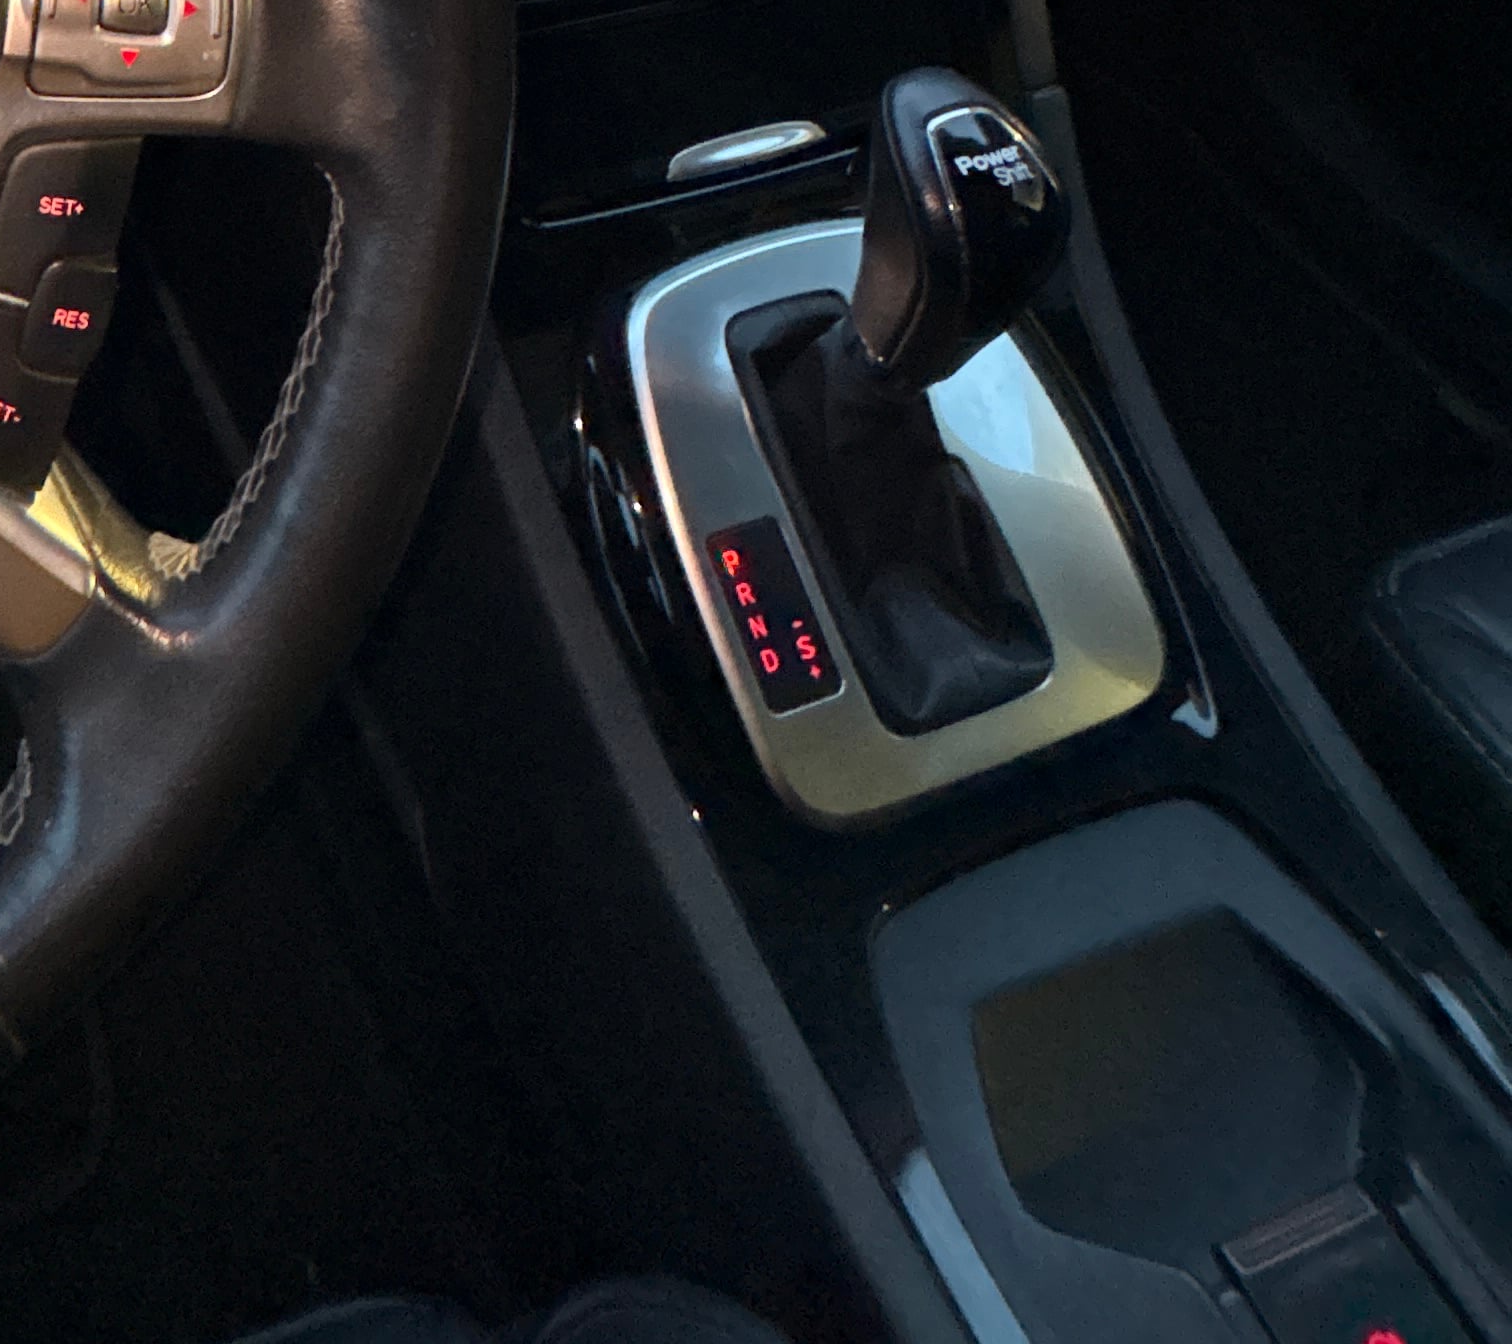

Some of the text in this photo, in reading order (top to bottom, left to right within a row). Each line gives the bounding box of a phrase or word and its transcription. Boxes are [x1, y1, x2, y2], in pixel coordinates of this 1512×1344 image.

[38, 195, 87, 217] SET+
[52, 307, 90, 330] RES
[721, 549, 740, 577] P
[735, 581, 757, 606] R
[747, 614, 769, 639] N
[759, 647, 779, 673] D
[795, 635, 817, 660] S
